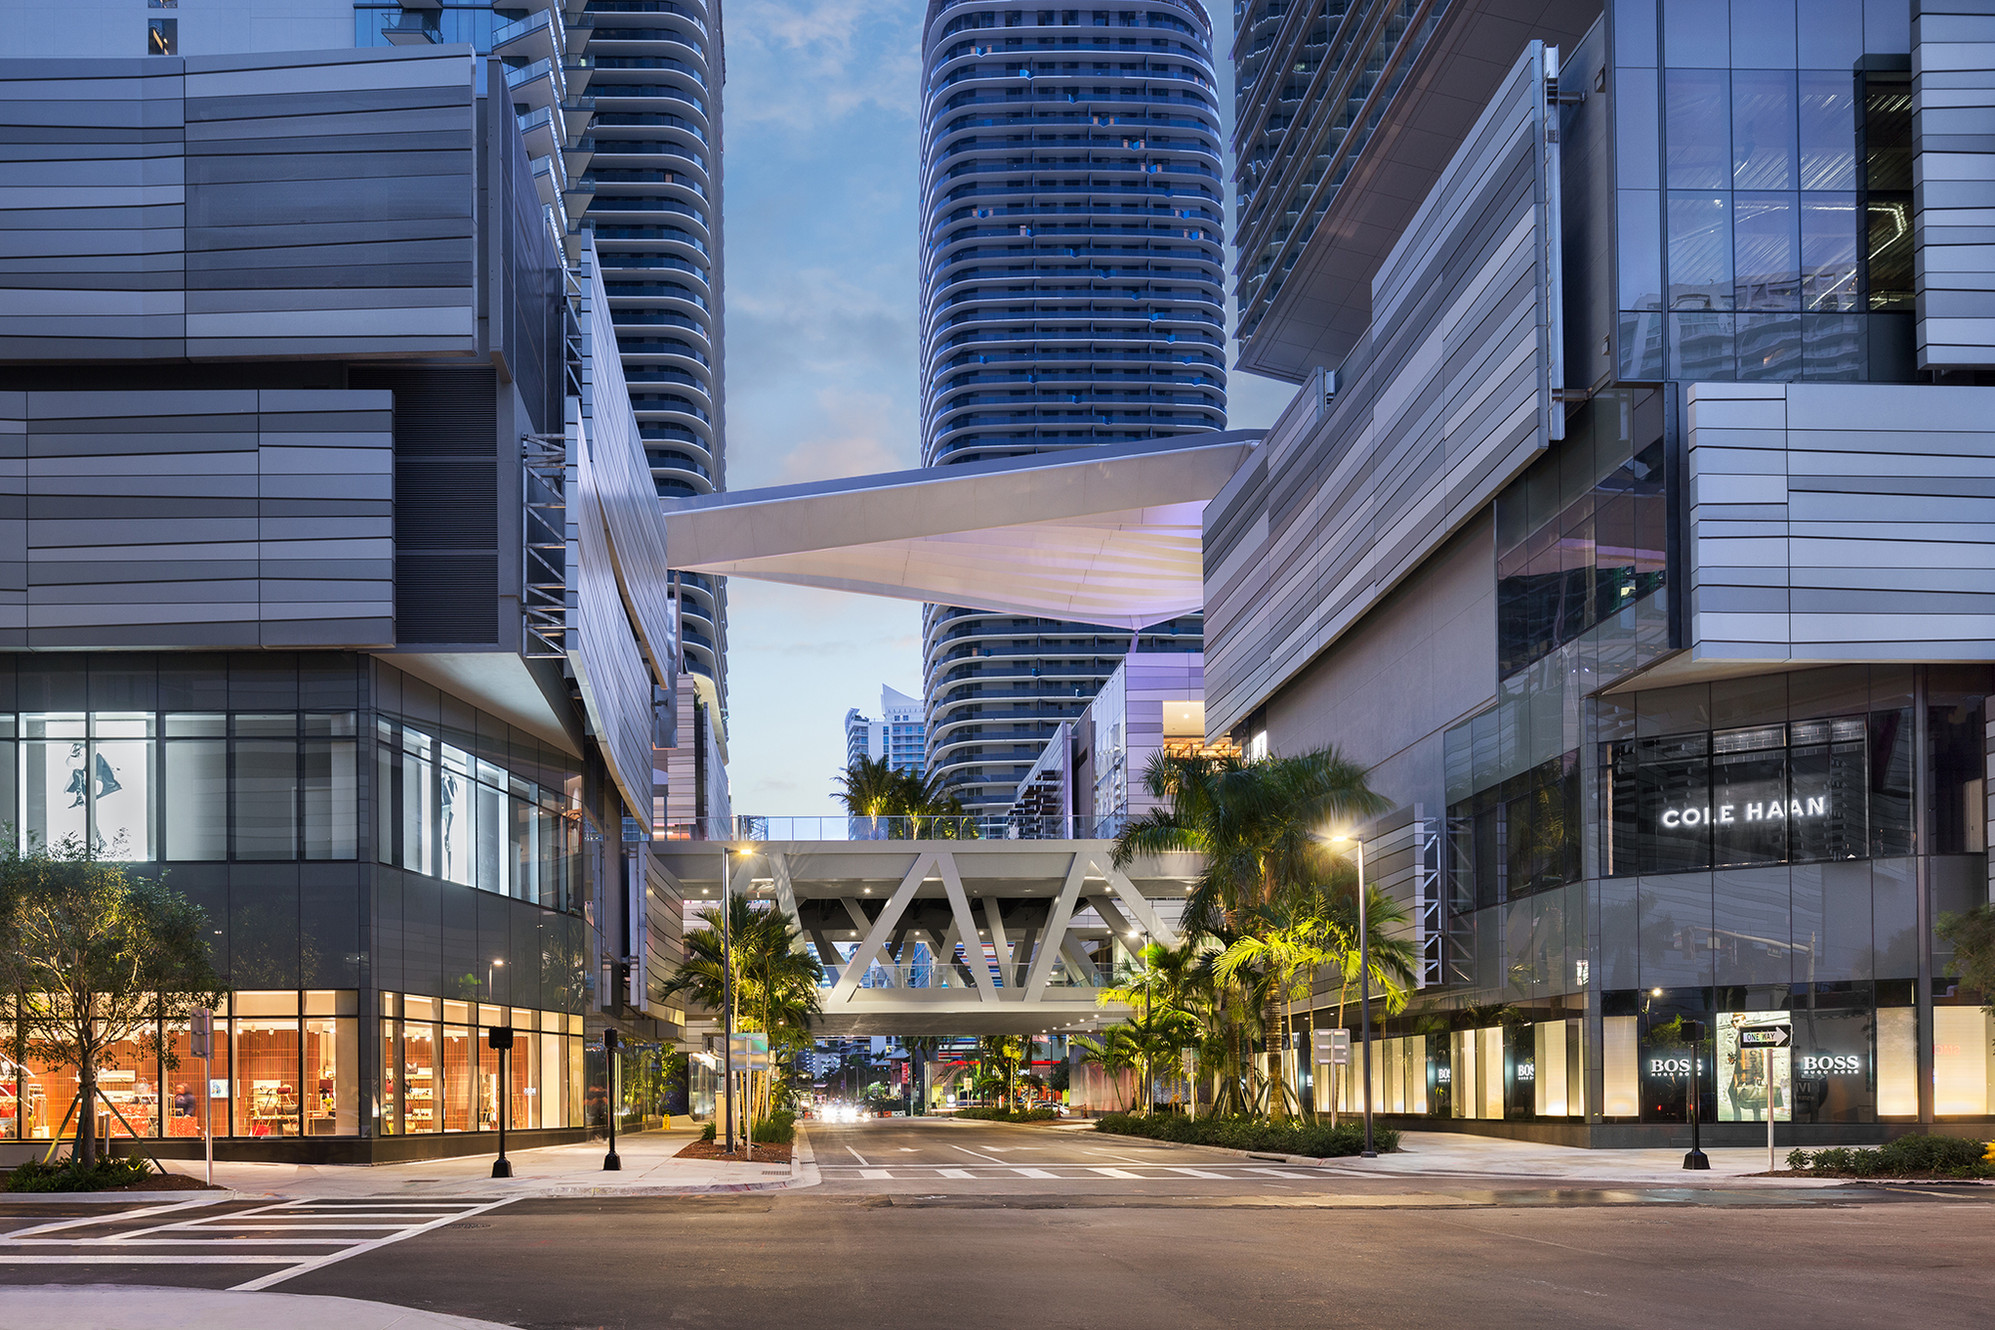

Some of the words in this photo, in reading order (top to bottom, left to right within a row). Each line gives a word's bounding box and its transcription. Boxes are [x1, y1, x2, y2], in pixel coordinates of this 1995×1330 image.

[1663, 805, 1735, 828] COLE
[1747, 797, 1824, 821] HAAN
[1747, 1033, 1760, 1041] ONE
[1803, 1056, 1860, 1069] BOSS
[1518, 1064, 1534, 1076] BOS
